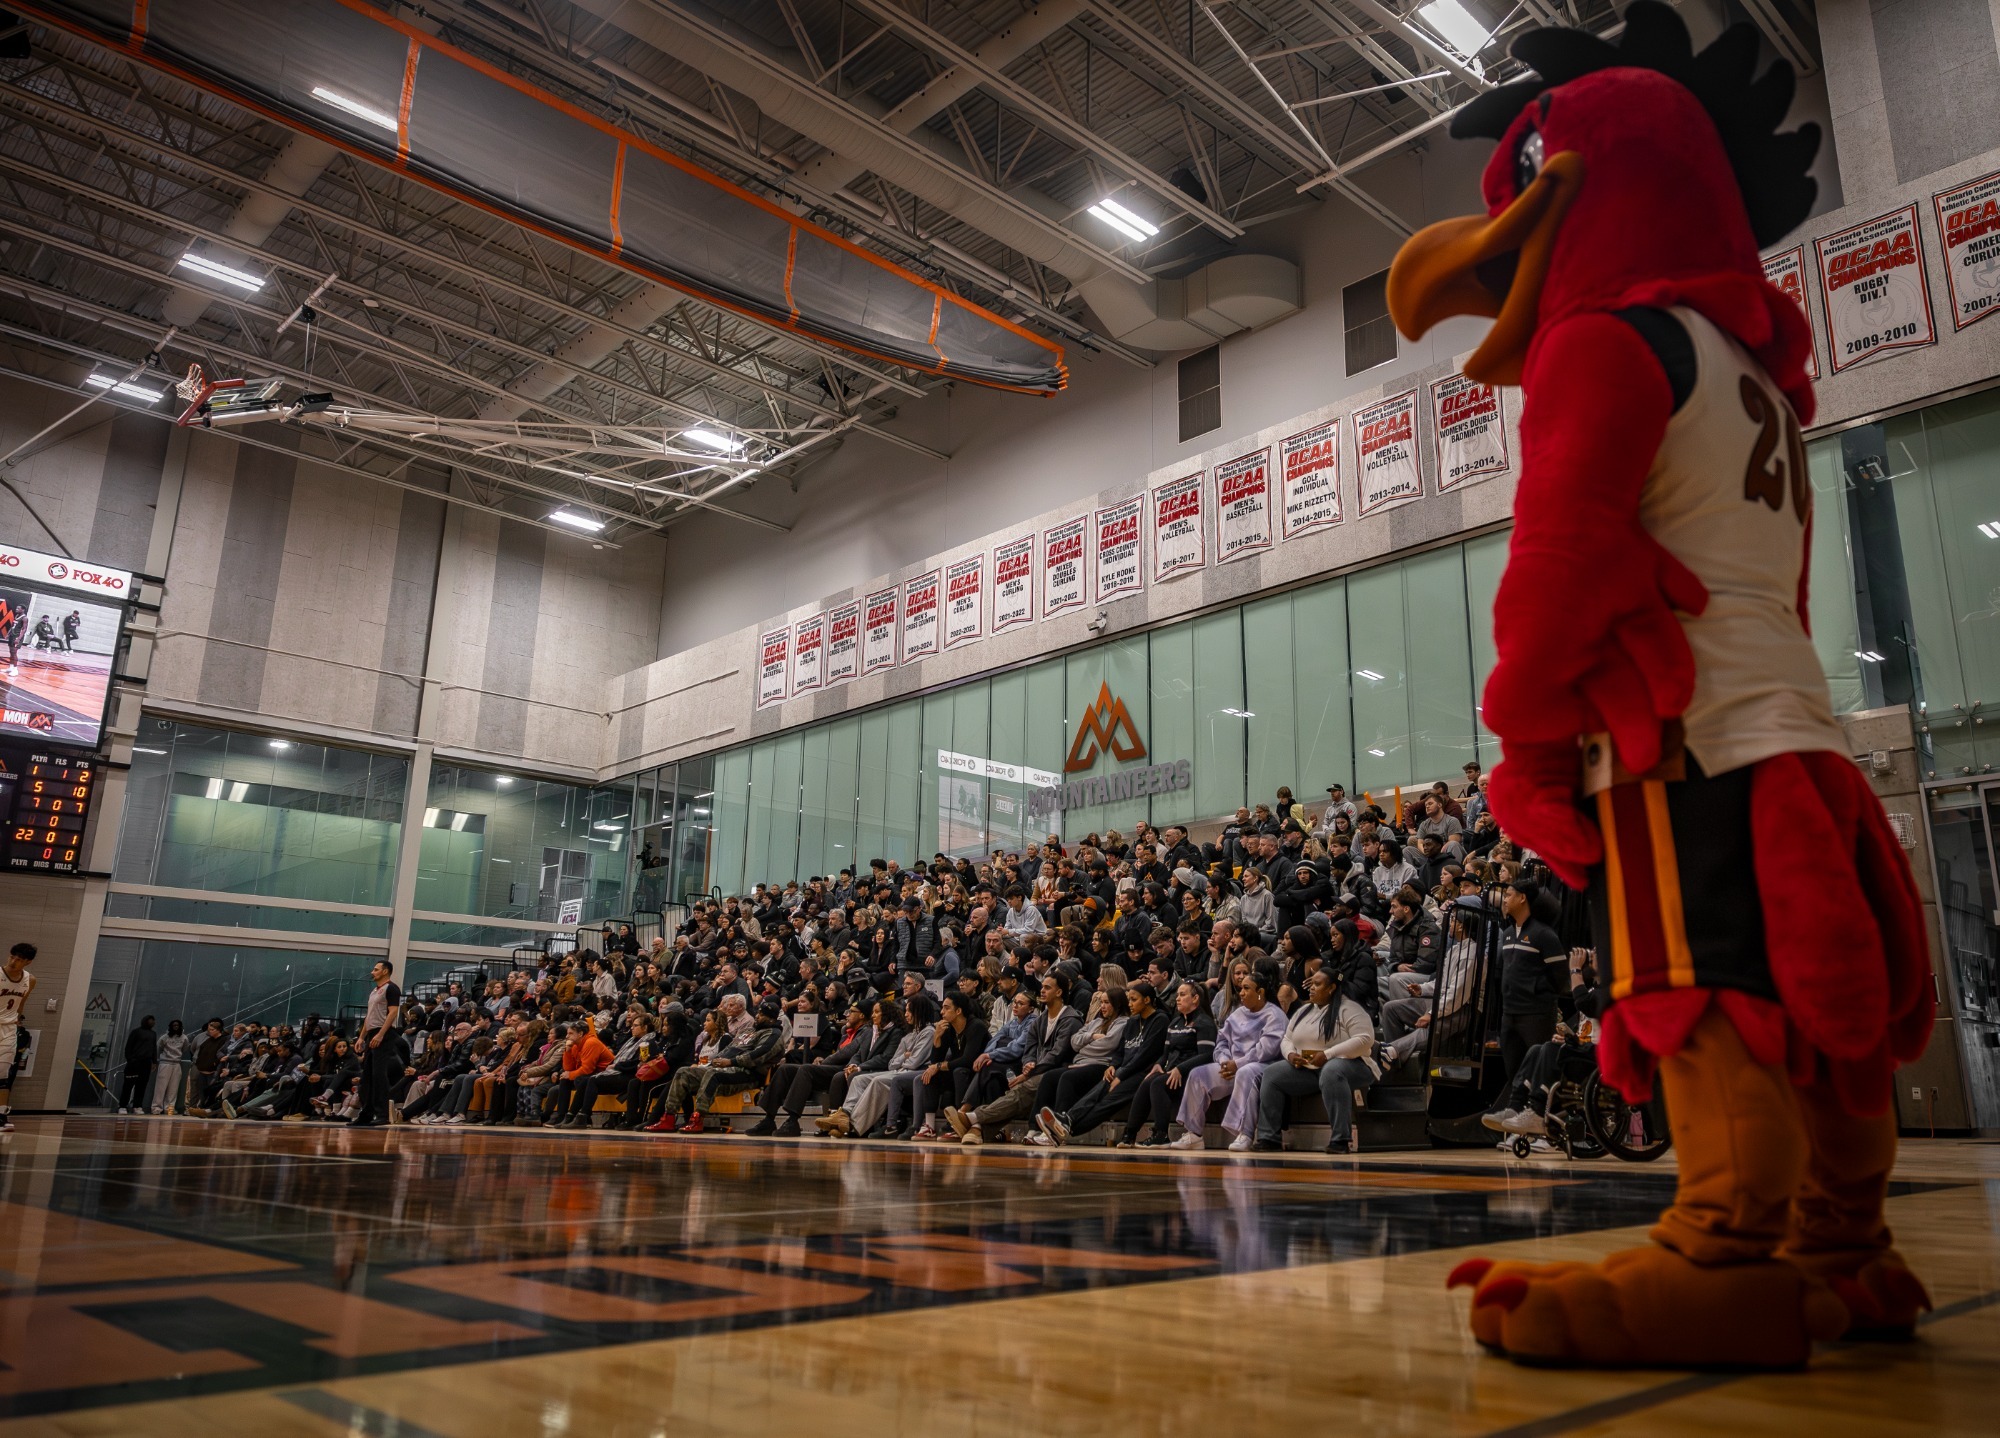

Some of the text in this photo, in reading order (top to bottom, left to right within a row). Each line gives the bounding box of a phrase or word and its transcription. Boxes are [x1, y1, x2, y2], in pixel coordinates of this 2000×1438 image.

[1942, 187, 2000, 213] Athletic Associa
[1946, 189, 1973, 203] Ontario
[1946, 198, 2000, 233] OCA
[1823, 220, 1912, 256] Athletic Association
[1829, 215, 1903, 247] Ontario Colleges
[1947, 216, 2000, 249] CHAMPIO
[1828, 230, 1913, 275] OCAA
[1828, 247, 1917, 292] CHAMPIONS
[1854, 273, 1890, 294] RUGBY
[1860, 289, 1882, 304] DIV.
[1846, 323, 1917, 354] 2009-2010
[1437, 386, 1460, 400] Athletic
[1441, 378, 1464, 392] Ontario
[1362, 398, 1408, 419] Ontario Colleges
[1441, 383, 1495, 416] OCAA
[1359, 403, 1413, 428] Athletic Association
[1440, 399, 1496, 430] CHAMPIONS
[1362, 410, 1411, 443] OCAA
[1440, 411, 1499, 439] WOMEN'S DOUBLES
[1451, 423, 1488, 443] BADMINTON
[1361, 426, 1412, 456] CHAMPIONS
[1287, 439, 1333, 470] OCAA
[1366, 450, 1409, 471] VOLLEYBALL
[1375, 445, 1399, 460] MEN'S
[1286, 455, 1335, 482] CHAMPIONS
[1449, 456, 1495, 478] 2013-2014
[1222, 467, 1264, 495] OCAA
[1293, 478, 1329, 496] INDIVIDUAL
[1302, 473, 1319, 485] GOLF
[1221, 482, 1265, 507] CHAMPIONS
[1369, 482, 1411, 502] 2013-2014
[1159, 489, 1199, 515] OCAA
[1234, 497, 1255, 511] MEN'S
[1287, 491, 1336, 514] MIKE RIZZETTO
[1158, 504, 1200, 528] CHAMPIONS
[1226, 503, 1263, 521] BASKETBALL
[1292, 508, 1331, 527] 2014-2015
[1101, 515, 1138, 539] OCAA
[1161, 525, 1196, 541] VOLLEYBALL
[1169, 519, 1188, 531] MEN'S
[1048, 533, 1082, 558] OCAA
[1100, 530, 1138, 552] CHAMPIONS
[1100, 540, 1139, 560] CROSS COUNTRY
[1226, 533, 1261, 550] 2014-2015
[998, 552, 1030, 574] OCAA
[1047, 548, 1083, 569] CHAMPIONS
[1056, 561, 1072, 572] MIXED
[1103, 551, 1134, 566] INDIVIDUAL
[1162, 553, 1195, 569] 2016-2017
[950, 571, 980, 592] OCAA
[996, 566, 1030, 586] CHAMPIONS
[1052, 566, 1077, 581] DOUBLES
[1053, 573, 1076, 588] CURLING
[1101, 572, 1116, 584] KYLE
[948, 584, 980, 603] CHAMPIONS
[1002, 584, 1024, 598] CURLING
[1005, 579, 1021, 589] MEN'S
[907, 586, 936, 607] OCAA
[956, 597, 972, 607] MEN'S
[868, 600, 895, 621] OCAA
[906, 599, 936, 619] CHAMPIONS
[832, 615, 856, 634] OCAA
[867, 614, 895, 632] CHAMPIONS
[798, 628, 822, 646] OCAA
[831, 628, 857, 644] CHAMPIONS
[764, 641, 787, 658] OCAA
[797, 639, 822, 656] CHAMPIONS
[763, 653, 787, 667] CHAMPIONS
[3, 709, 30, 725] MOH
[31, 754, 89, 769] PLYR FLS PTS
[32, 765, 39, 775] 1
[79, 771, 89, 782] 2
[34, 781, 87, 798] 5 10
[1027, 759, 1191, 817] MOUNTAINEERS
[33, 797, 84, 813] 7 0 7
[49, 815, 59, 827] 0
[15, 828, 34, 841] 22
[46, 831, 56, 843] 0
[43, 848, 74, 861] 0 0
[11, 858, 28, 867] PLYR
[54, 862, 73, 871] KILLS
